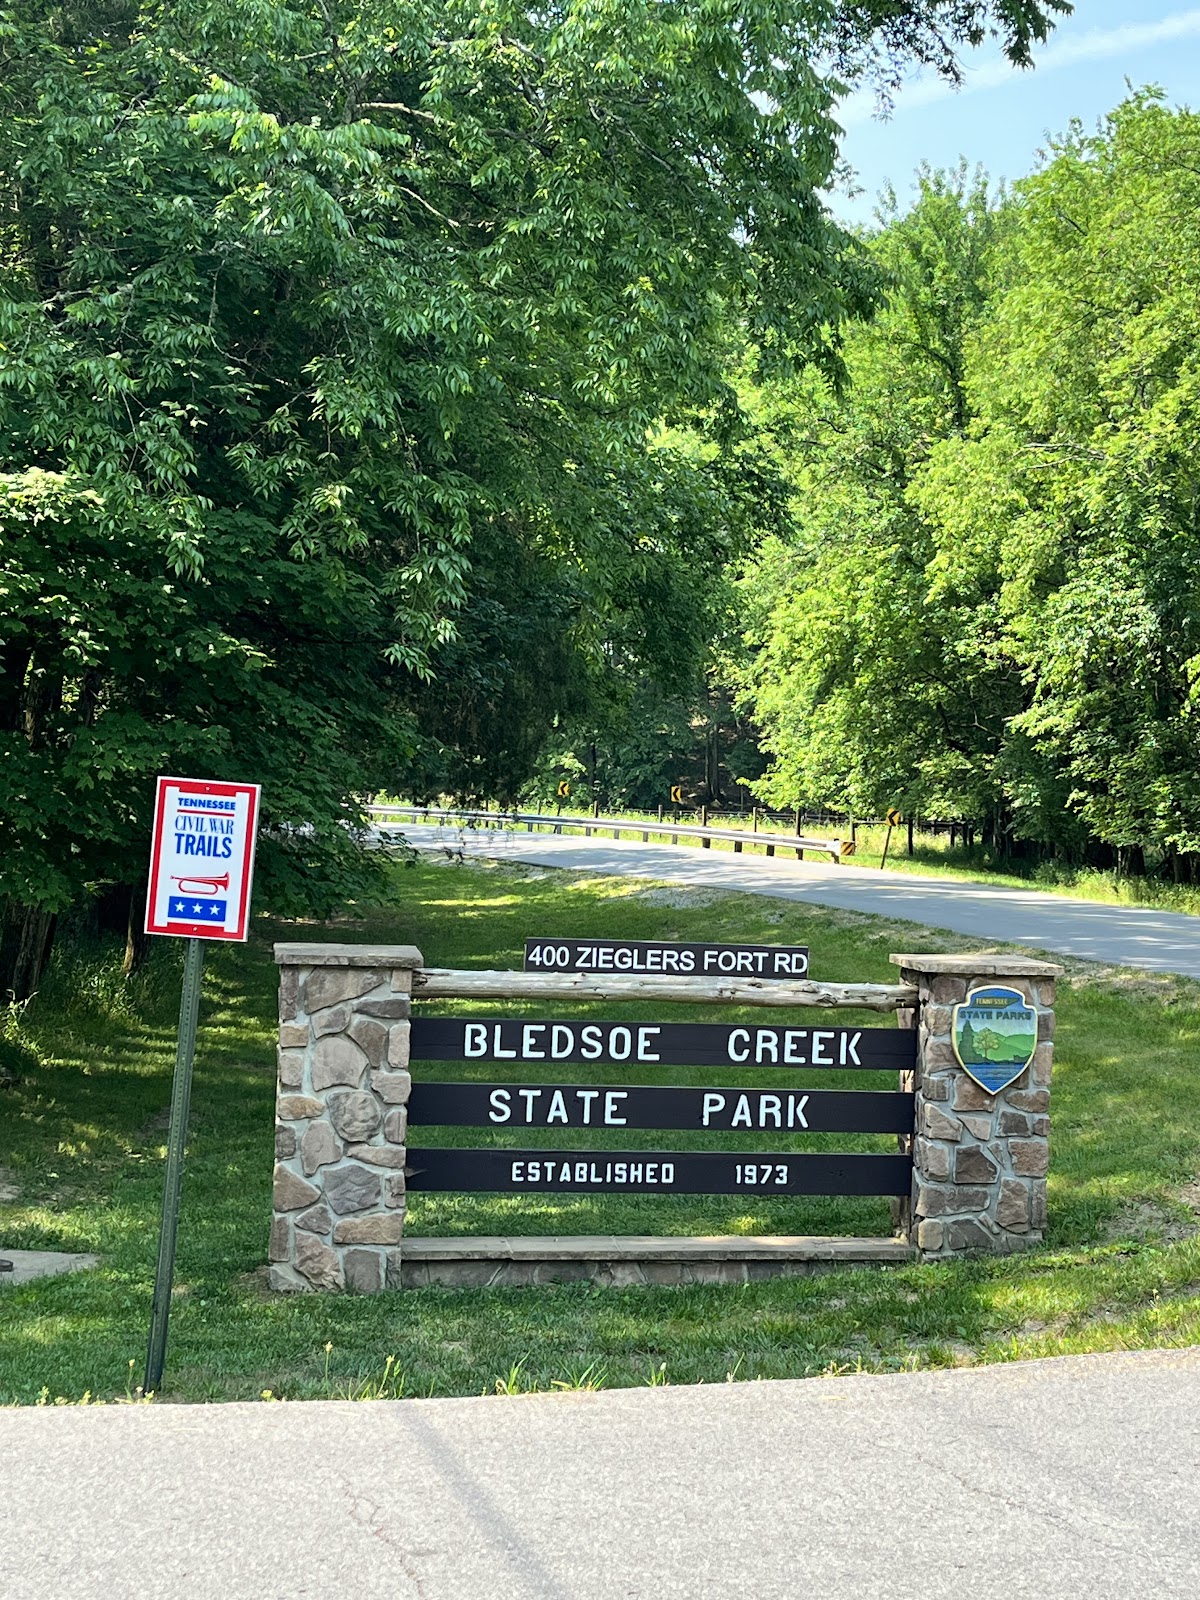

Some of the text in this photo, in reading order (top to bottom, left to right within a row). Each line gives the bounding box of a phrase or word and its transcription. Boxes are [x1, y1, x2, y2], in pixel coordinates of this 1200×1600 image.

[178, 797, 236, 810] TENNESSEE
[175, 815, 234, 835] CIVIL WAR
[175, 833, 232, 858] TRAILS
[528, 945, 808, 974] 400 ZIEGLERS FORT RD
[959, 1011, 1032, 1020] STATE PARKS
[463, 1023, 863, 1066] BLEDSOE CREEK
[488, 1089, 809, 1129] STATE PARK
[511, 1161, 789, 1186] ESTABLISHED 1973
